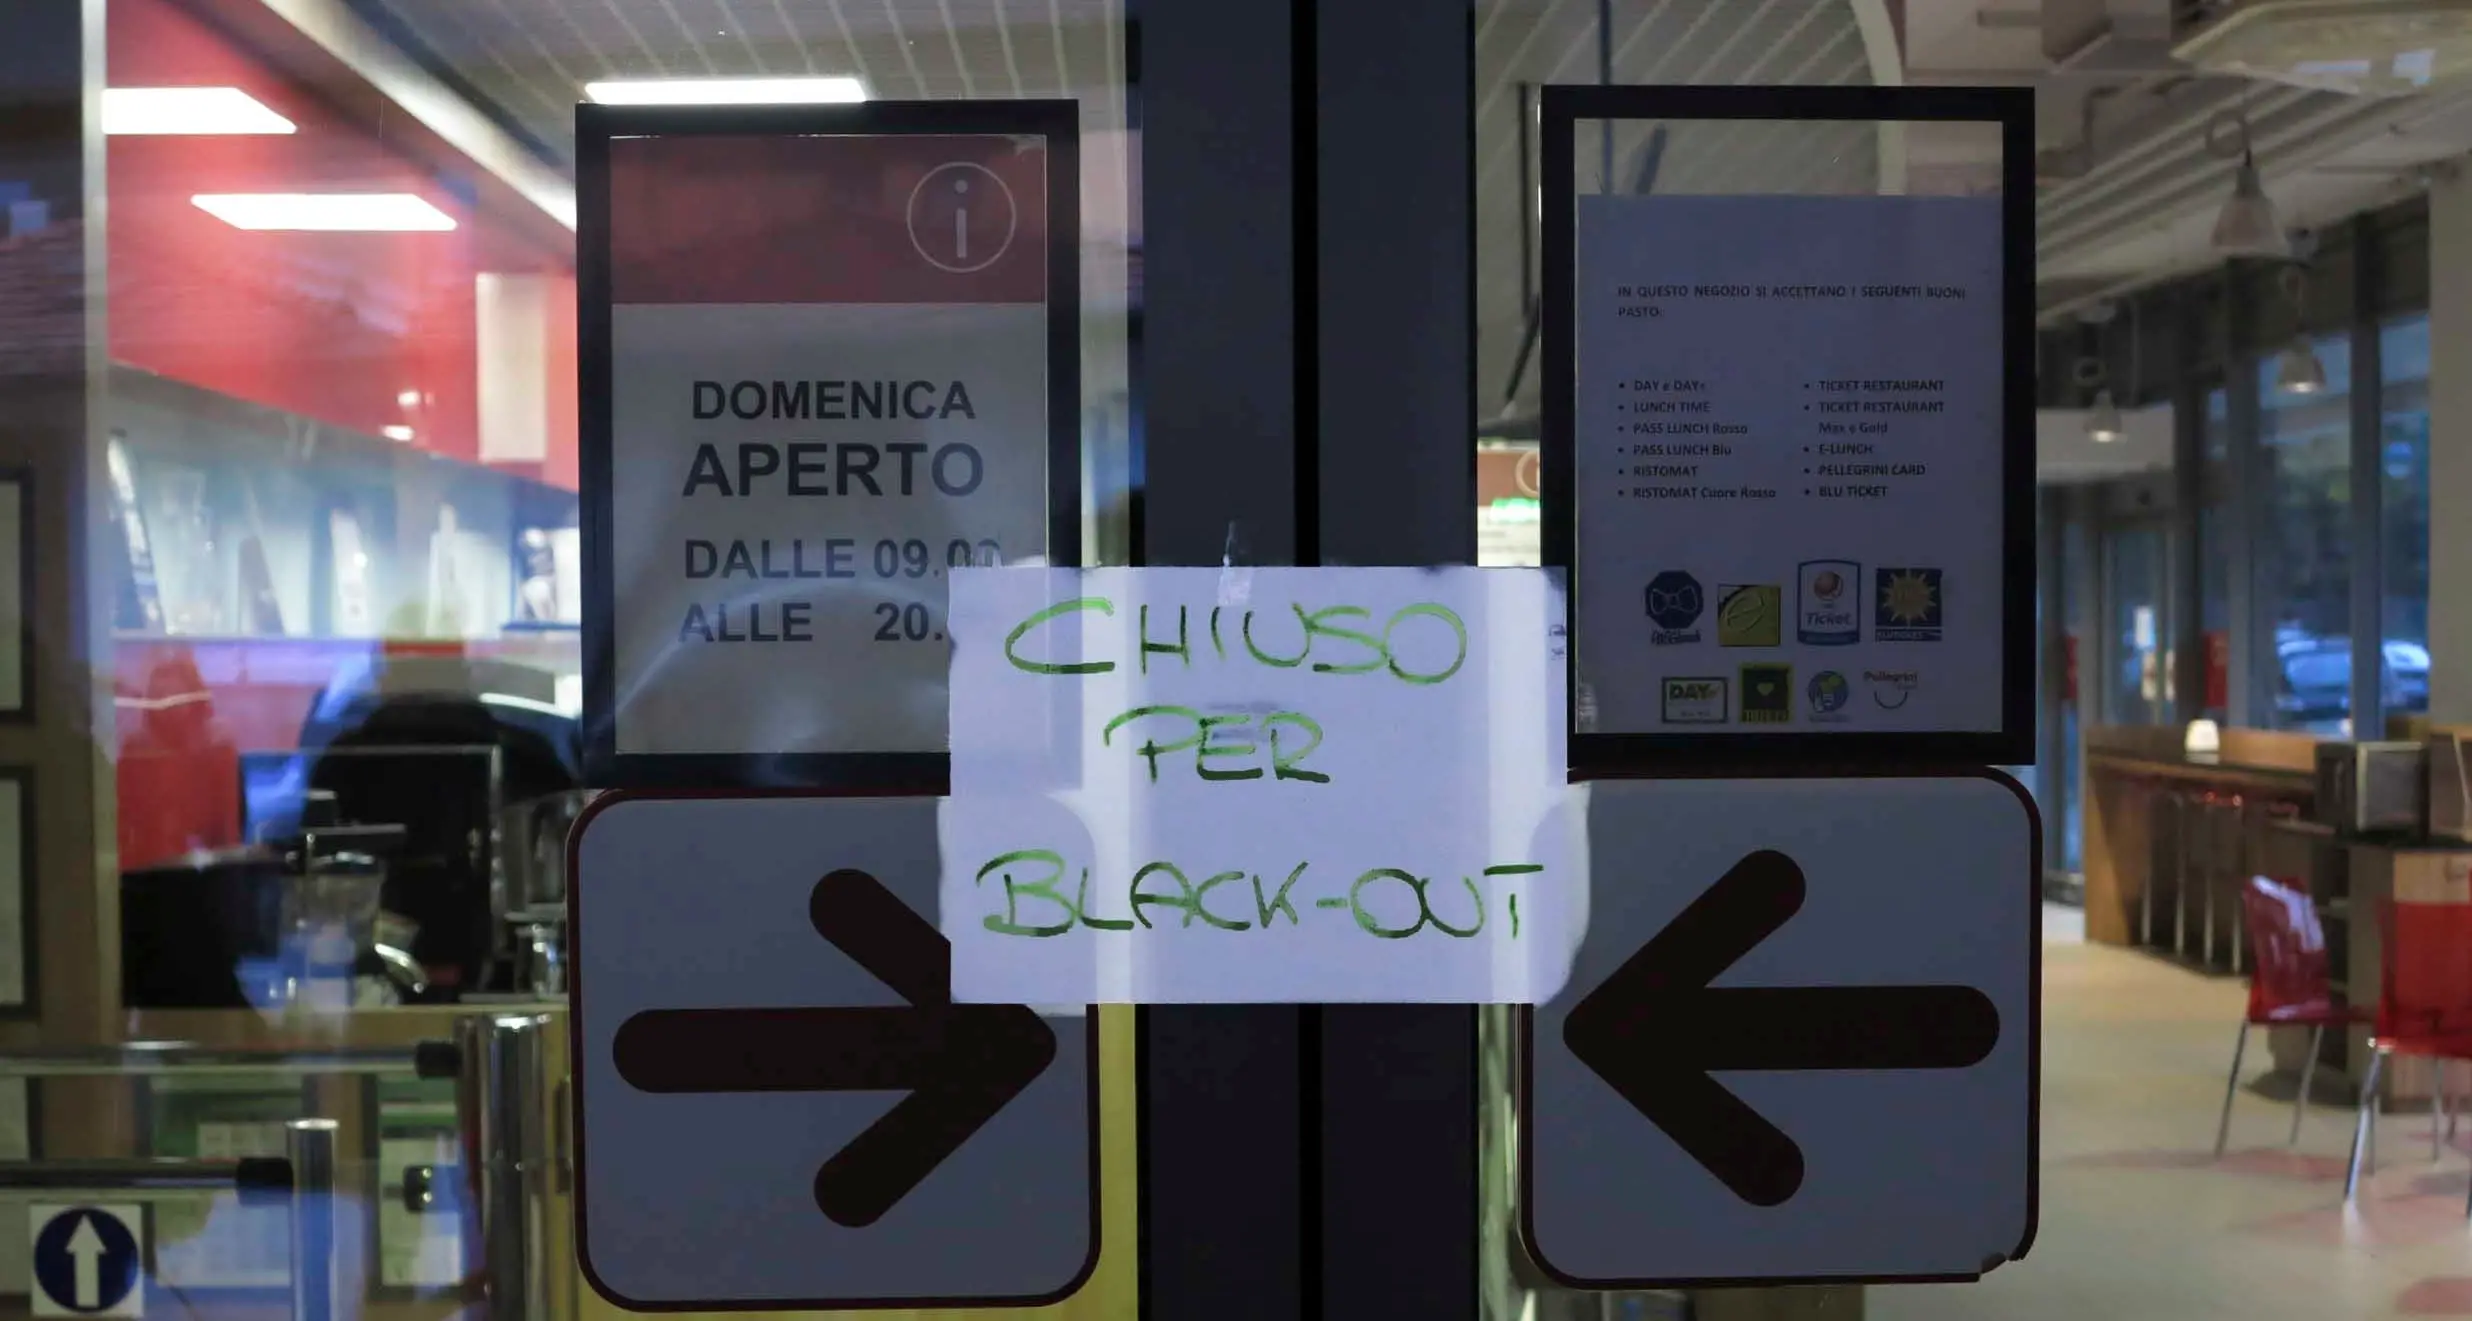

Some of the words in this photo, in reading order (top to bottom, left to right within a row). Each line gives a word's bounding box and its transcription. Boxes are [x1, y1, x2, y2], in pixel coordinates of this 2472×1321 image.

[1617, 285, 1631, 298] IN
[1637, 285, 1688, 299] QUESTO
[1695, 285, 1750, 299] NEGOZIO
[1756, 285, 1766, 298] SI
[1772, 285, 1845, 299] ACCETTANO
[1861, 286, 1921, 299] SEGUENTI
[1927, 286, 1965, 299] BUONI
[1617, 306, 1665, 319] PASTO:
[1634, 380, 1659, 391] DAY
[1819, 380, 1859, 391] TICKET
[1864, 380, 1944, 392] RESTAURANT
[693, 380, 976, 420] DOMENICA
[1634, 401, 1675, 413] LUNCH
[1679, 401, 1710, 413] TIME
[1819, 401, 1859, 413] TICKET
[1864, 401, 1944, 413] RESTAURANT
[1633, 422, 1663, 434] PASS
[1667, 422, 1709, 434] LUNCH
[1713, 422, 1748, 434] Rosso
[1860, 421, 1888, 433] Gold
[1633, 444, 1663, 456] PASS
[1666, 444, 1708, 456] LUNCH
[1712, 444, 1732, 456] Blu
[1819, 443, 1873, 455] E-LUNCH
[682, 443, 984, 497] APERTO
[1633, 465, 1699, 477] RISTOMAT
[1819, 464, 1888, 476] PELLEGRINI
[1892, 464, 1926, 476] CARD
[1633, 487, 1696, 499] RISTOMAT
[1701, 487, 1736, 499] Cuore
[1740, 487, 1776, 499] Rosso
[1819, 486, 1842, 497] BLU
[1847, 486, 1888, 497] TICKET
[685, 539, 855, 579] DALLE
[679, 602, 812, 642] ALLE
[874, 602, 943, 642] 20.
[1005, 597, 1467, 685] CHIUSO
[1104, 705, 1330, 783] PER
[976, 849, 1543, 940] BLACK-OUT
